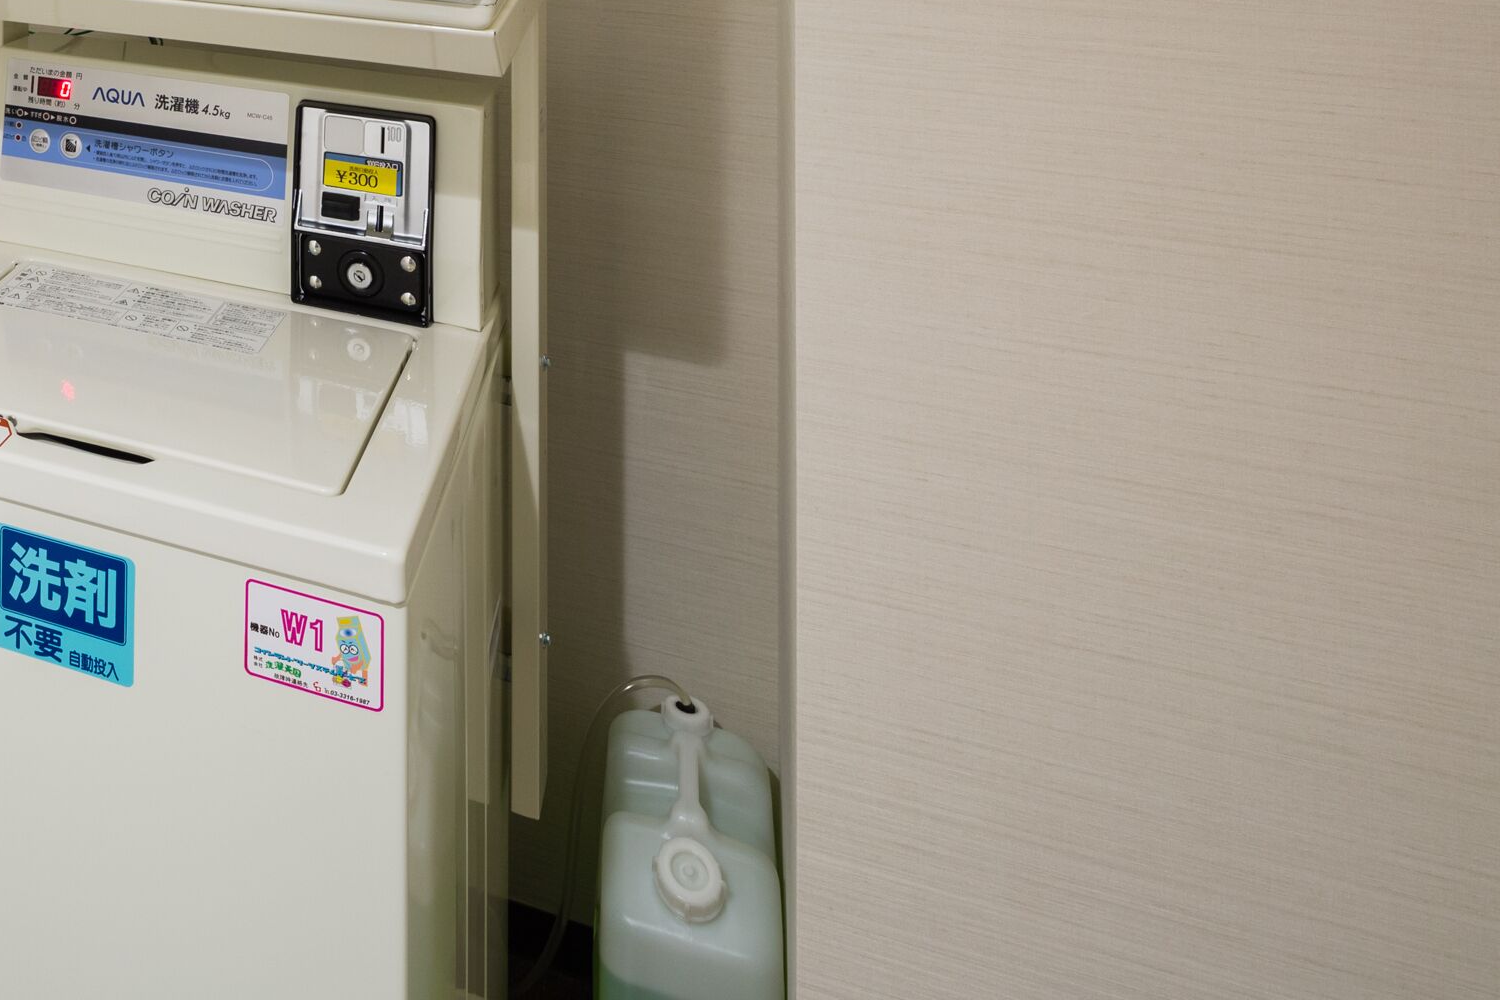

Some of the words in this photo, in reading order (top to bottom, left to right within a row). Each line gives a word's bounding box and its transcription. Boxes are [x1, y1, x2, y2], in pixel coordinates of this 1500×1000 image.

[29, 66, 73, 79] ただいまの金額
[75, 72, 83, 80] 円
[59, 81, 71, 98] 0
[92, 86, 145, 108] AQUA
[154, 93, 200, 115] 洗濯機
[201, 103, 231, 120] 4.5kg
[386, 126, 402, 143] 100
[94, 138, 175, 159] 洗濯槽シャワーボタン
[335, 169, 379, 190] ¥300
[147, 187, 199, 210] COIN
[202, 196, 278, 224] WASHER
[8, 541, 117, 629] 洗剤
[280, 608, 323, 653] W1
[3, 614, 63, 663] 不要
[69, 650, 120, 682] 自動投入
